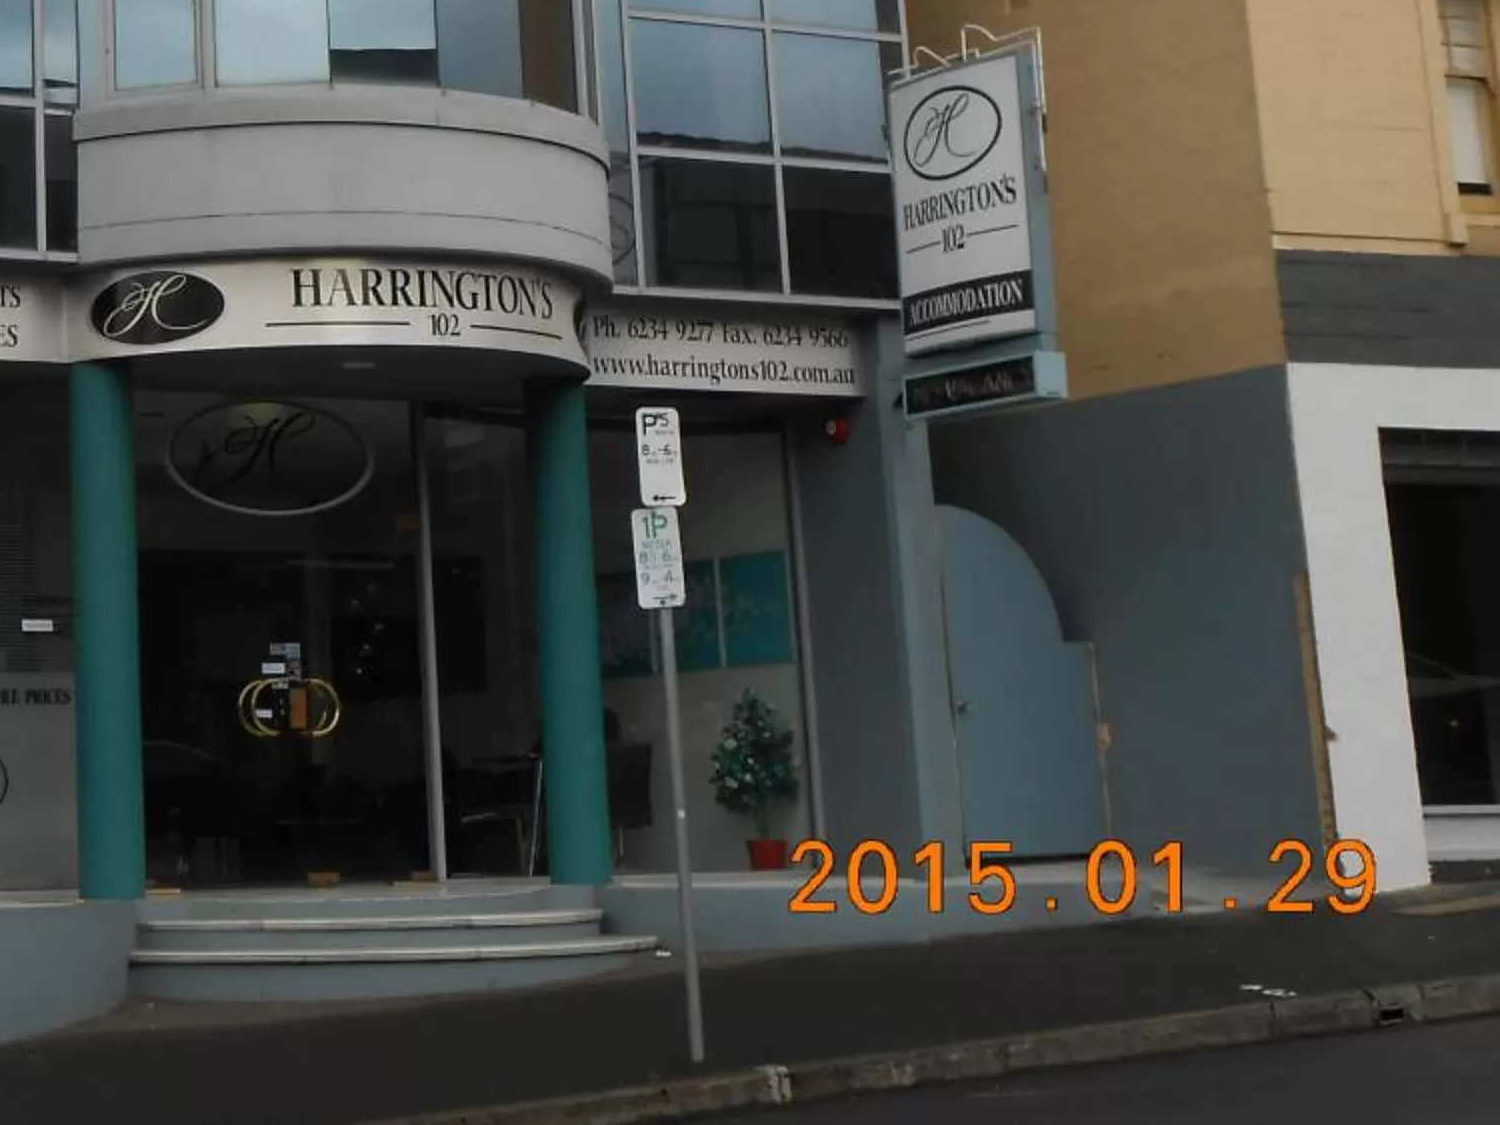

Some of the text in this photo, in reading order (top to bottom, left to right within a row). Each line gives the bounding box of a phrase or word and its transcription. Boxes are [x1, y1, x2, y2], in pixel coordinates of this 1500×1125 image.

[941, 224, 966, 254] 102
[289, 267, 556, 321] HARRINGTON'S
[909, 278, 1024, 326] ACCOMMODATION
[429, 312, 462, 338] 102
[593, 353, 856, 387] www.harringtons102.com.au
[24, 687, 73, 706] PRICES
